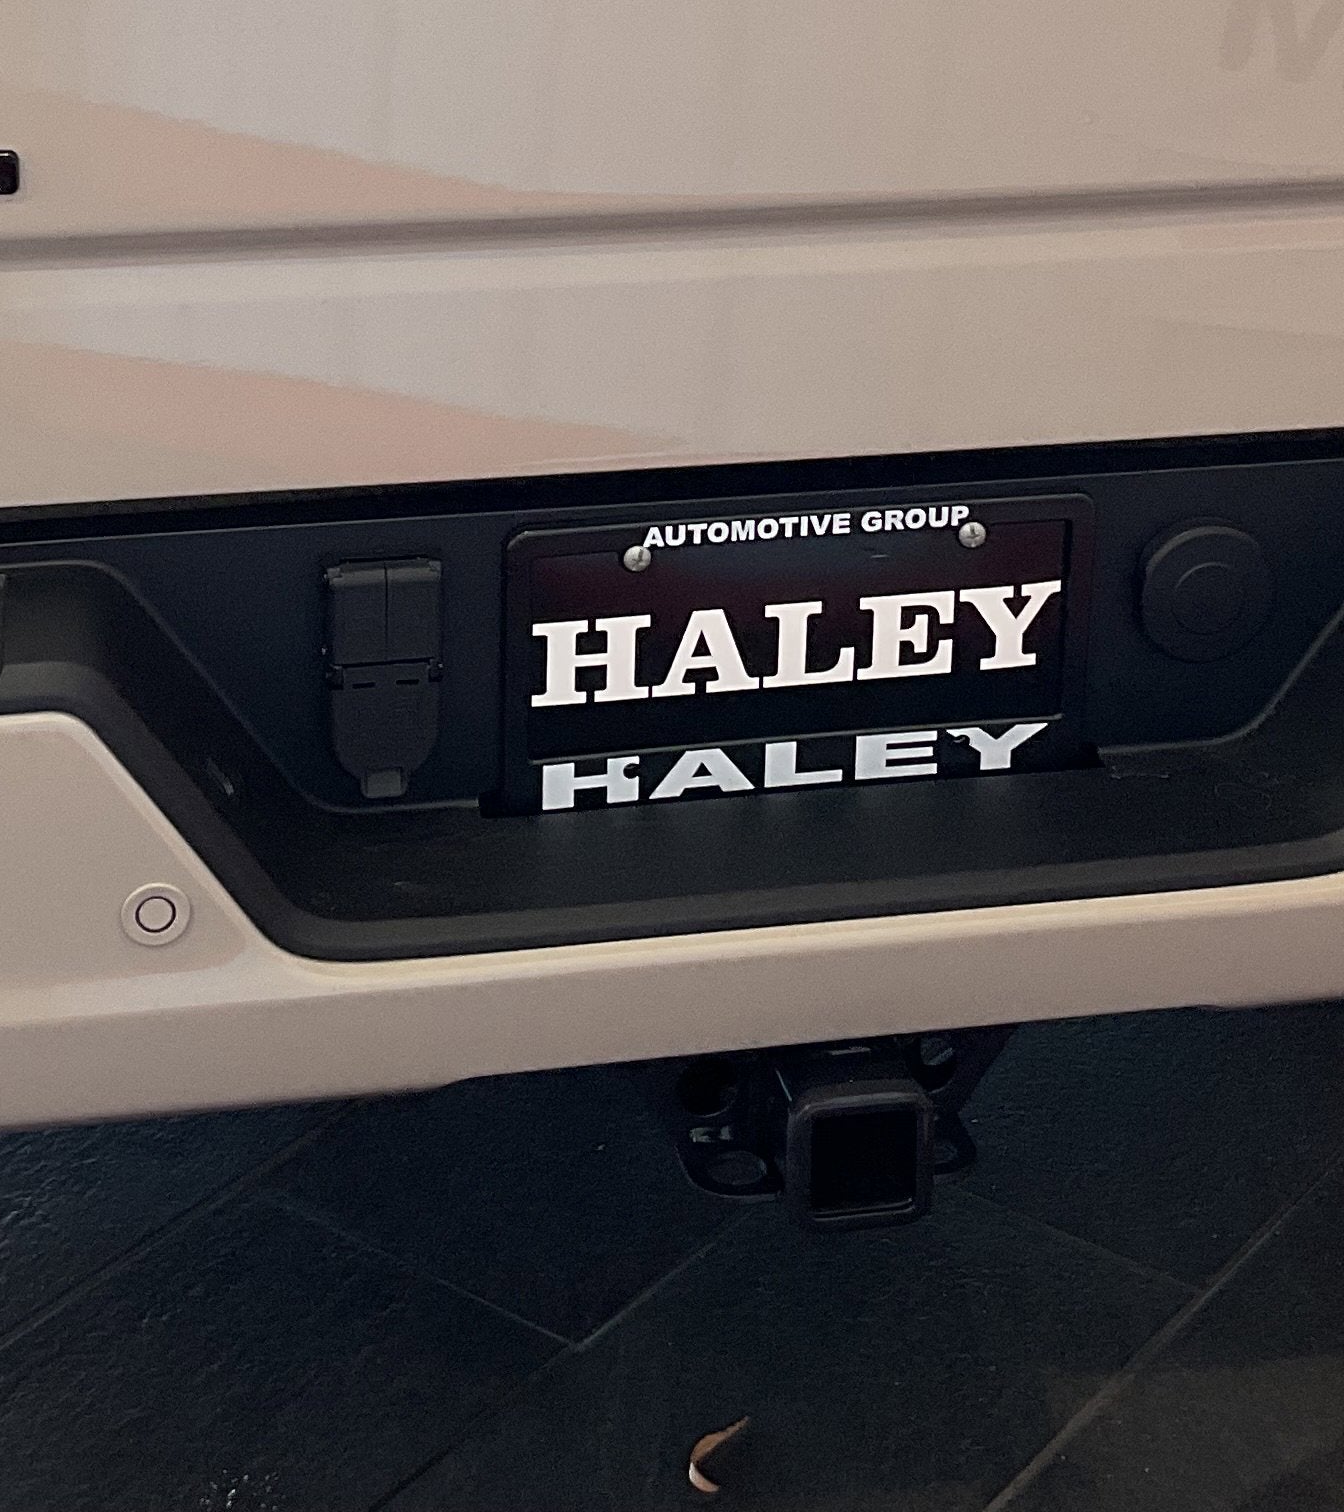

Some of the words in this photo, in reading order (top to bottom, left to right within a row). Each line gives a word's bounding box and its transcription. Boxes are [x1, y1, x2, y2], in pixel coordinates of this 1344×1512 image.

[642, 513, 853, 549] AUTOMOTIVE
[859, 505, 971, 534] GROUP
[530, 579, 1062, 708] HALEY
[540, 722, 1049, 812] HALEY
